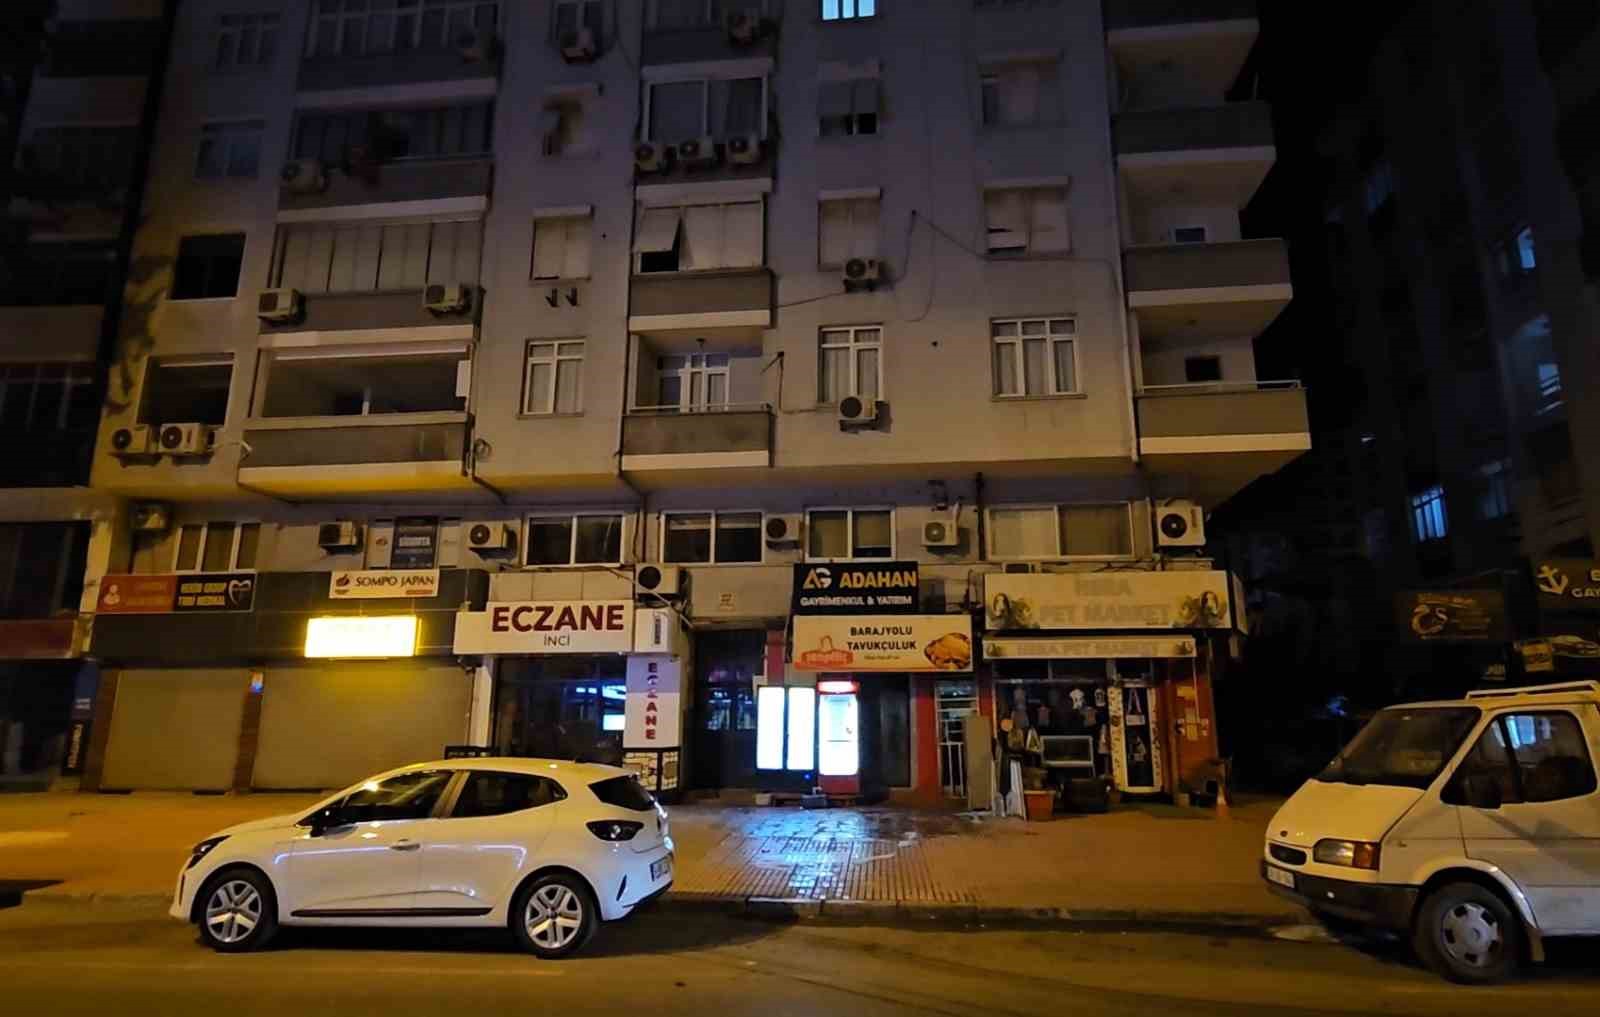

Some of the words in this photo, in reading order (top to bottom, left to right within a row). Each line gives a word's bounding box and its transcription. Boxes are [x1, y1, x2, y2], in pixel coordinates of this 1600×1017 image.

[356, 575, 398, 587] SOMPO
[400, 575, 434, 587] JAPAN
[840, 571, 916, 588] ADAHAN
[876, 594, 912, 605] YATIRIM
[492, 605, 624, 632] ECZANE
[850, 626, 913, 637] BARAJYOLU
[847, 640, 917, 652] TAVUKÇULUK
